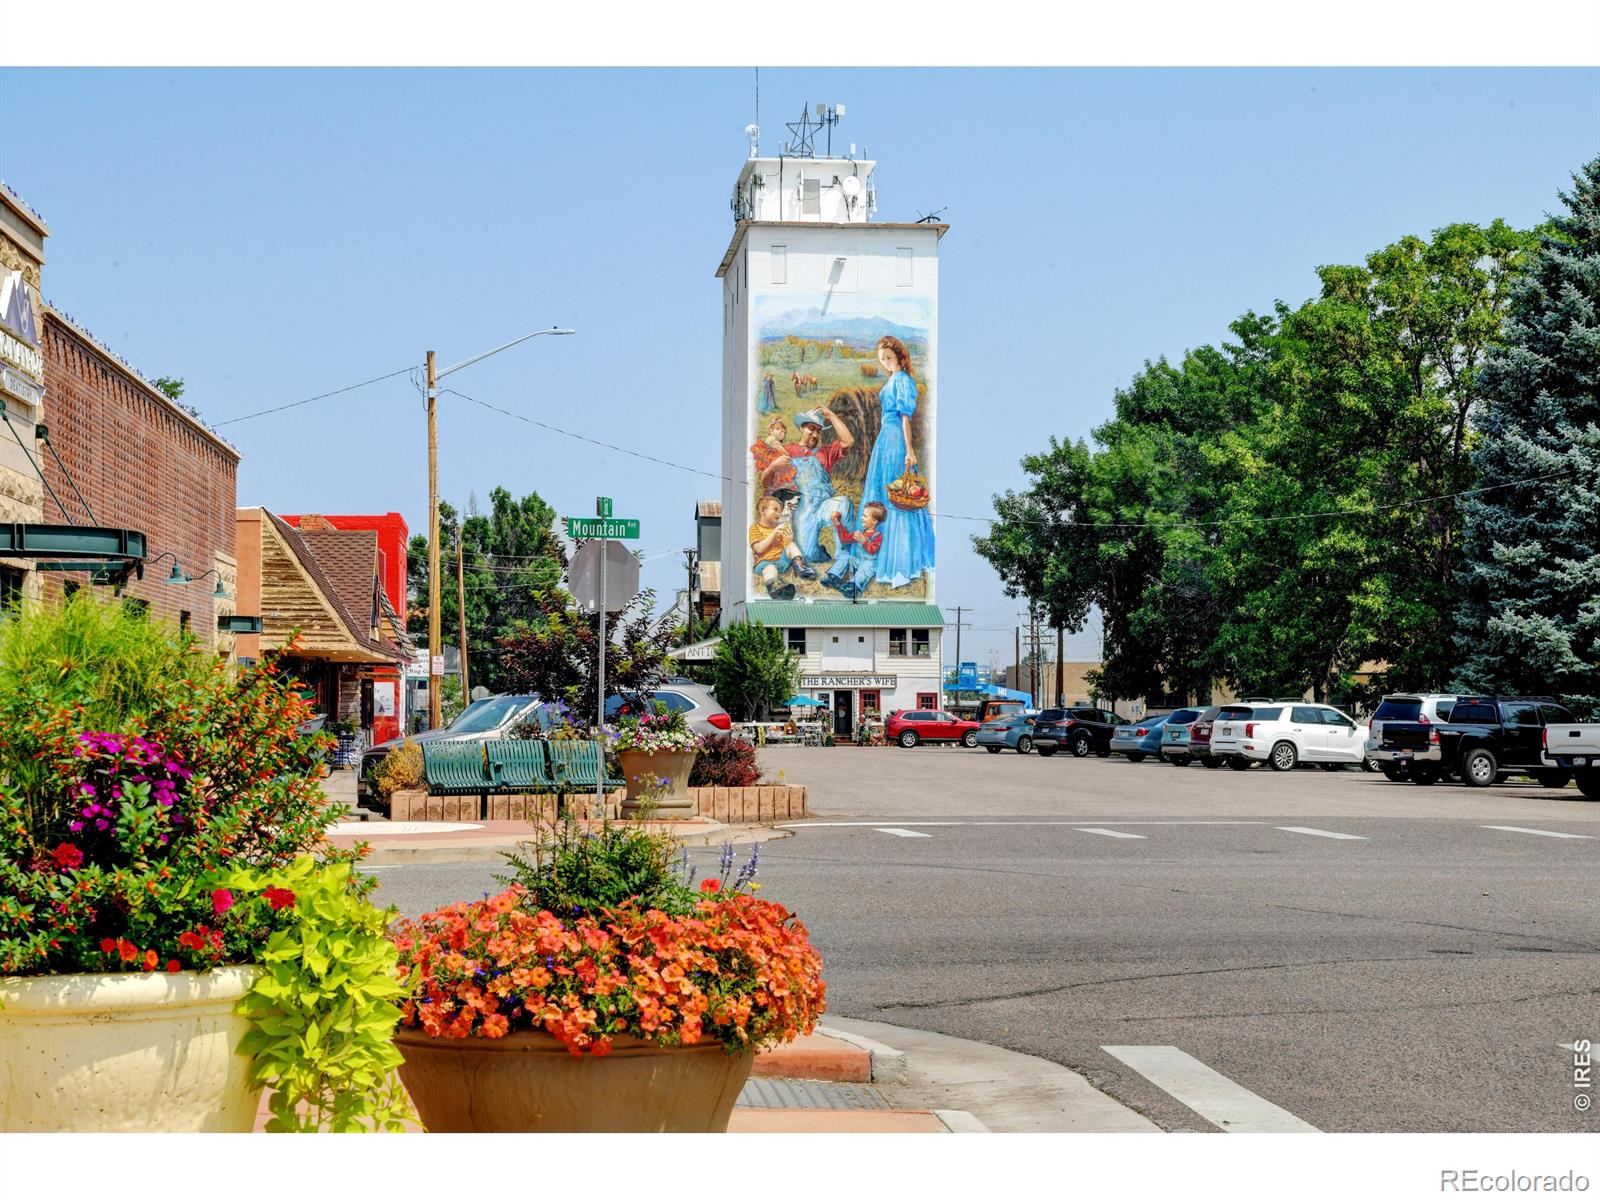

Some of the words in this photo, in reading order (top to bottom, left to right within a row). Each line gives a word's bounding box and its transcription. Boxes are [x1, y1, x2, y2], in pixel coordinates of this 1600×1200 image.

[572, 520, 626, 537] Mountain
[802, 677, 819, 686] THE
[821, 677, 871, 686] RANCHER'S
[872, 677, 896, 686] WIFE
